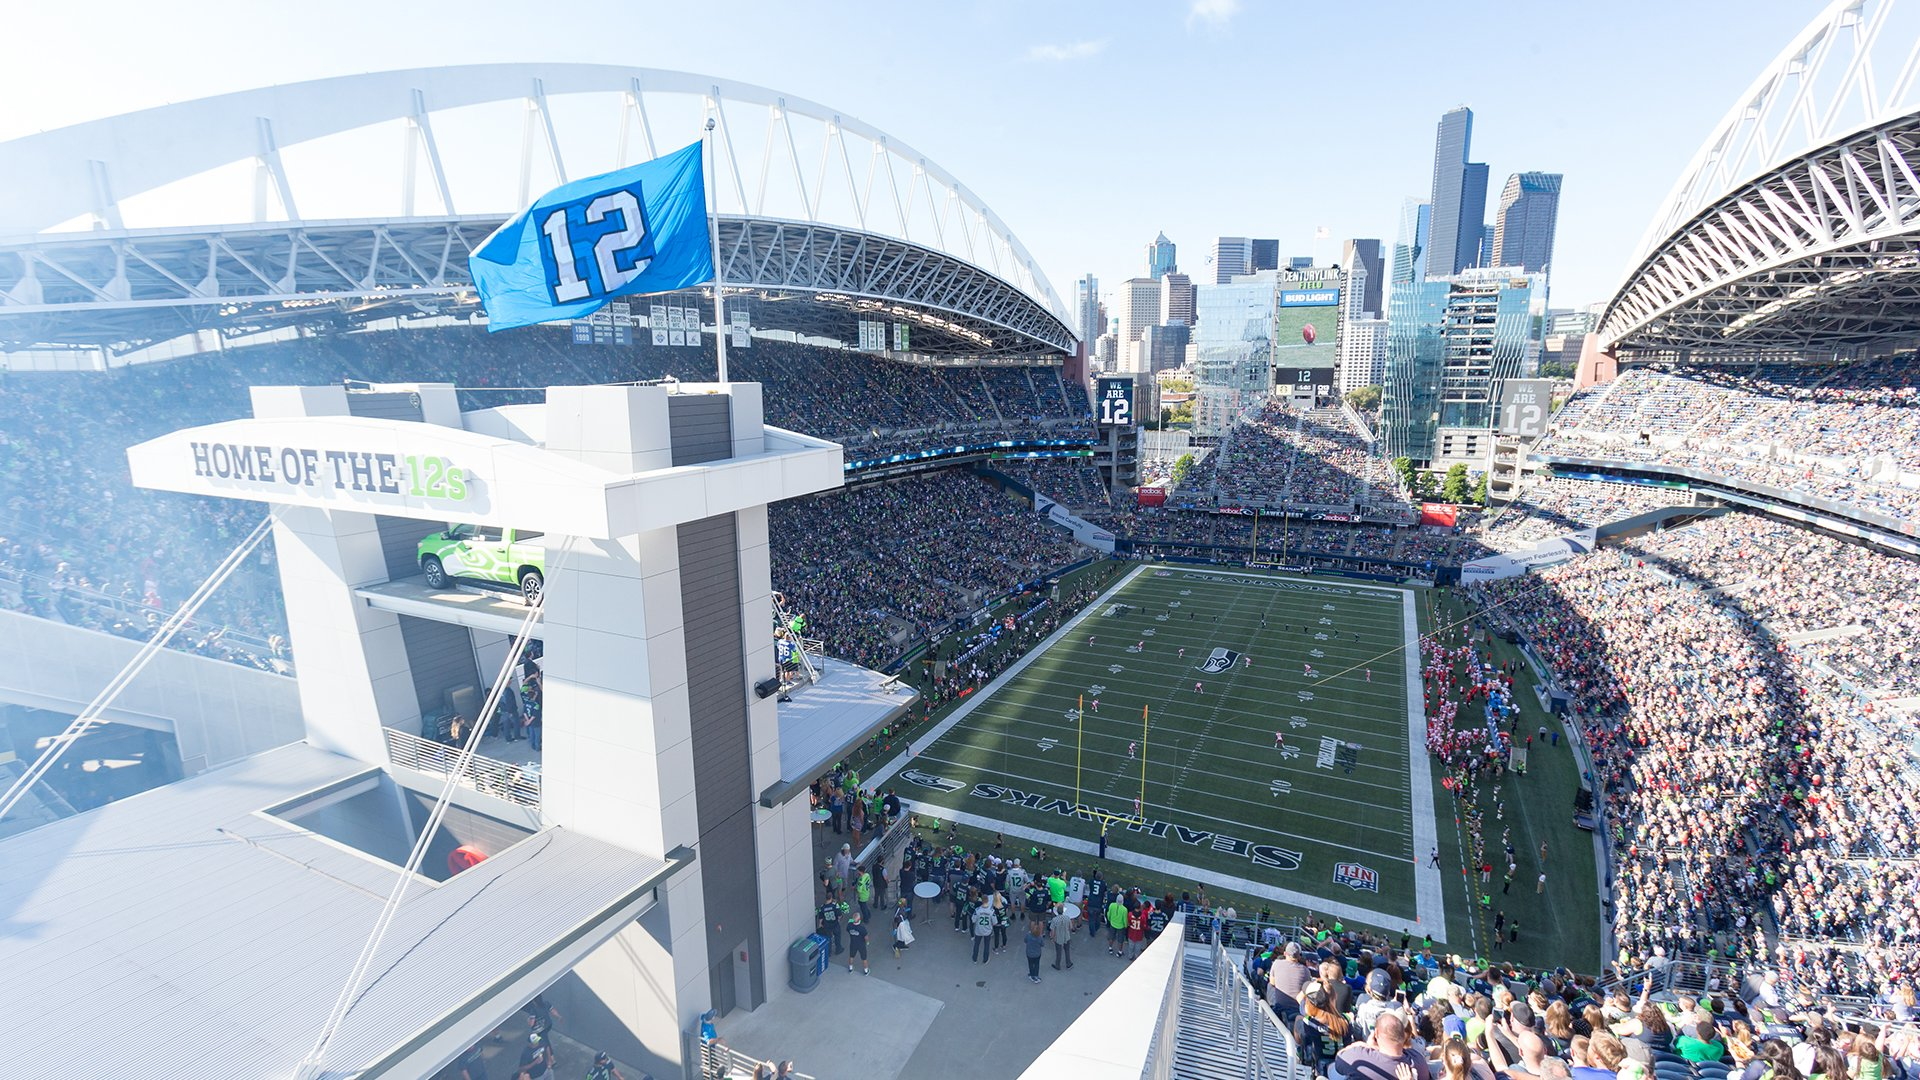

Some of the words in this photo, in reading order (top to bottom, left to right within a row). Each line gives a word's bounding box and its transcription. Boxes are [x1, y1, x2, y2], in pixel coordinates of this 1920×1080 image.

[542, 189, 653, 303] 12
[1283, 270, 1340, 281] CENTURYLINK
[1299, 281, 1323, 289] FIELD
[1285, 294, 1305, 302] BUD
[1306, 293, 1334, 301] LIGHT
[1297, 370, 1311, 382] 12
[1110, 381, 1122, 389] WE
[1518, 384, 1535, 393] WE
[1106, 390, 1125, 399] ARE
[1512, 394, 1536, 404] ARE
[1101, 398, 1129, 424] 12
[1502, 404, 1541, 437] 12
[190, 442, 276, 482] HOME
[280, 446, 319, 487] OF
[325, 450, 400, 494] THE
[406, 455, 467, 500] 12s
[1511, 556, 1533, 565] Dream
[1534, 548, 1567, 562] Fearlessly
[969, 783, 1303, 870] SEAHAWKS
[1340, 864, 1373, 881] NFL
[1011, 877, 1022, 887] 12
[1073, 883, 1079, 892] 3
[1092, 886, 1100, 895] 3
[979, 917, 990, 926] 25
[1130, 919, 1141, 930] 31
[1150, 920, 1164, 931] 25
